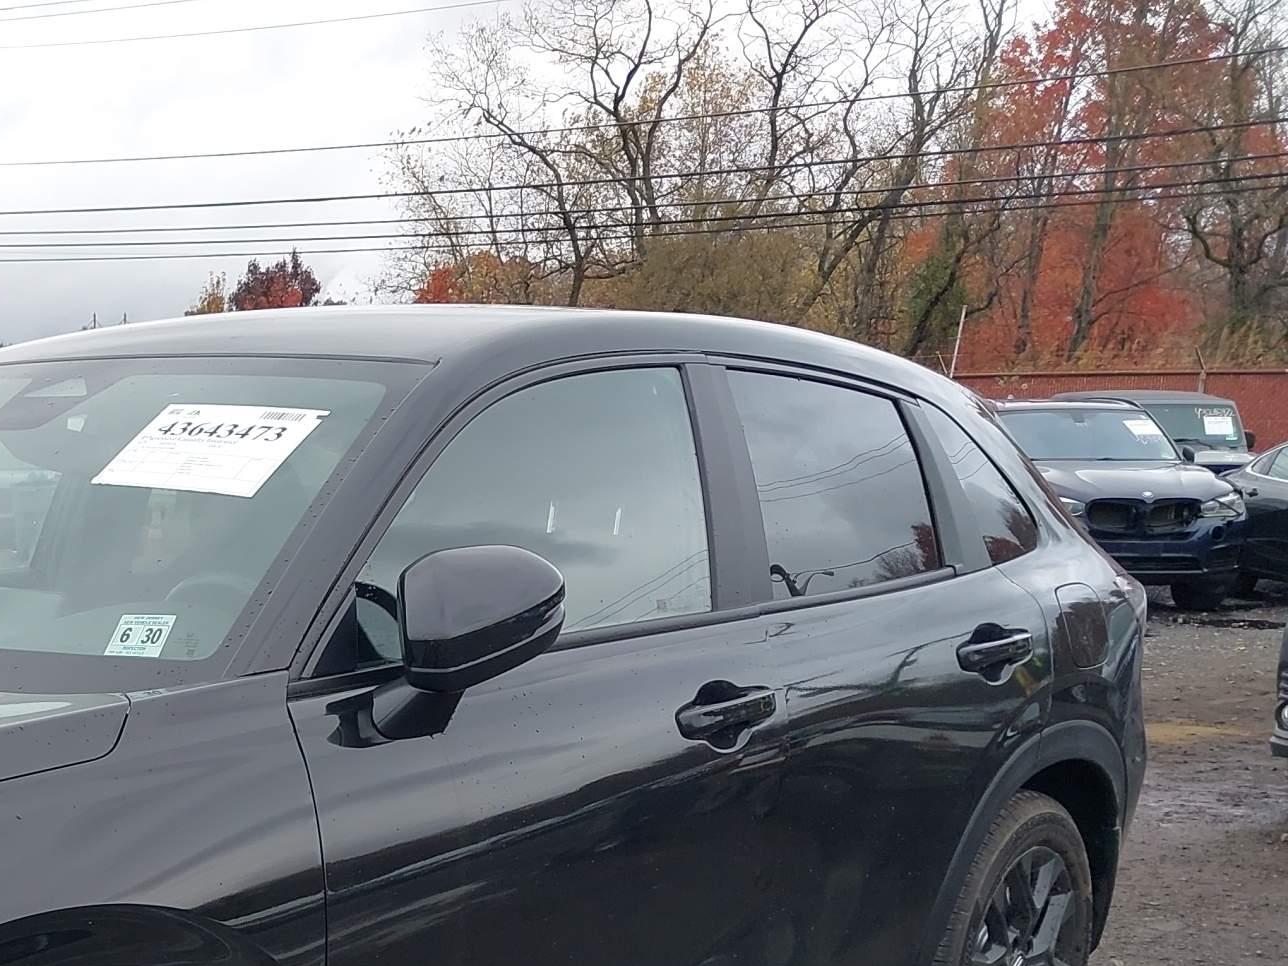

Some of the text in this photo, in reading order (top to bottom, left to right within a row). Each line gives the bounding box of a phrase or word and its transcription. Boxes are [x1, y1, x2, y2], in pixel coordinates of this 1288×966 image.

[158, 421, 287, 442] 43643473
[119, 627, 163, 645] 6 30
